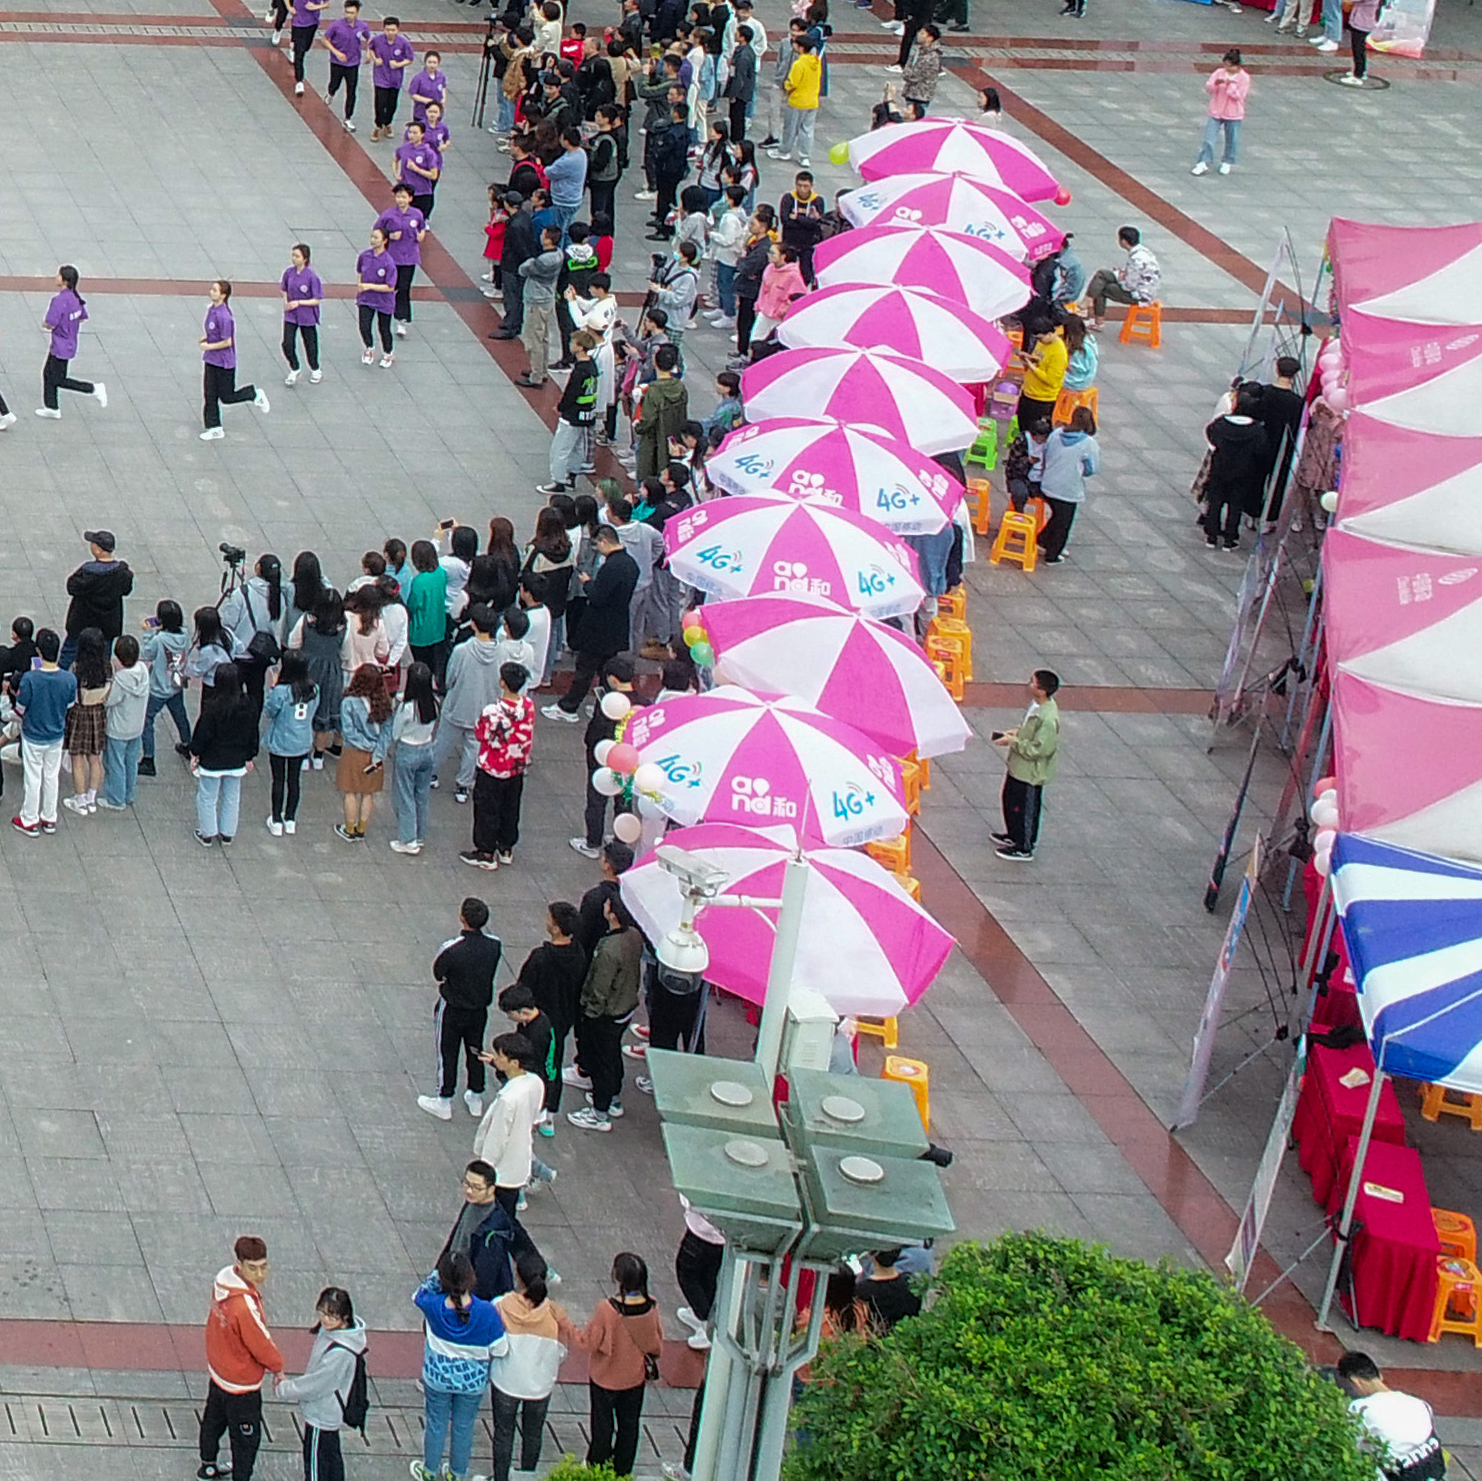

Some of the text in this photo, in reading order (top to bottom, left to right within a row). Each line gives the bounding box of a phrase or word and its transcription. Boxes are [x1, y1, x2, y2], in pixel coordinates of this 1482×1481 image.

[877, 488, 920, 512] 4G+
[858, 572, 895, 597] 4G+
[295, 703, 307, 720] 8
[832, 791, 875, 821] 4G+
